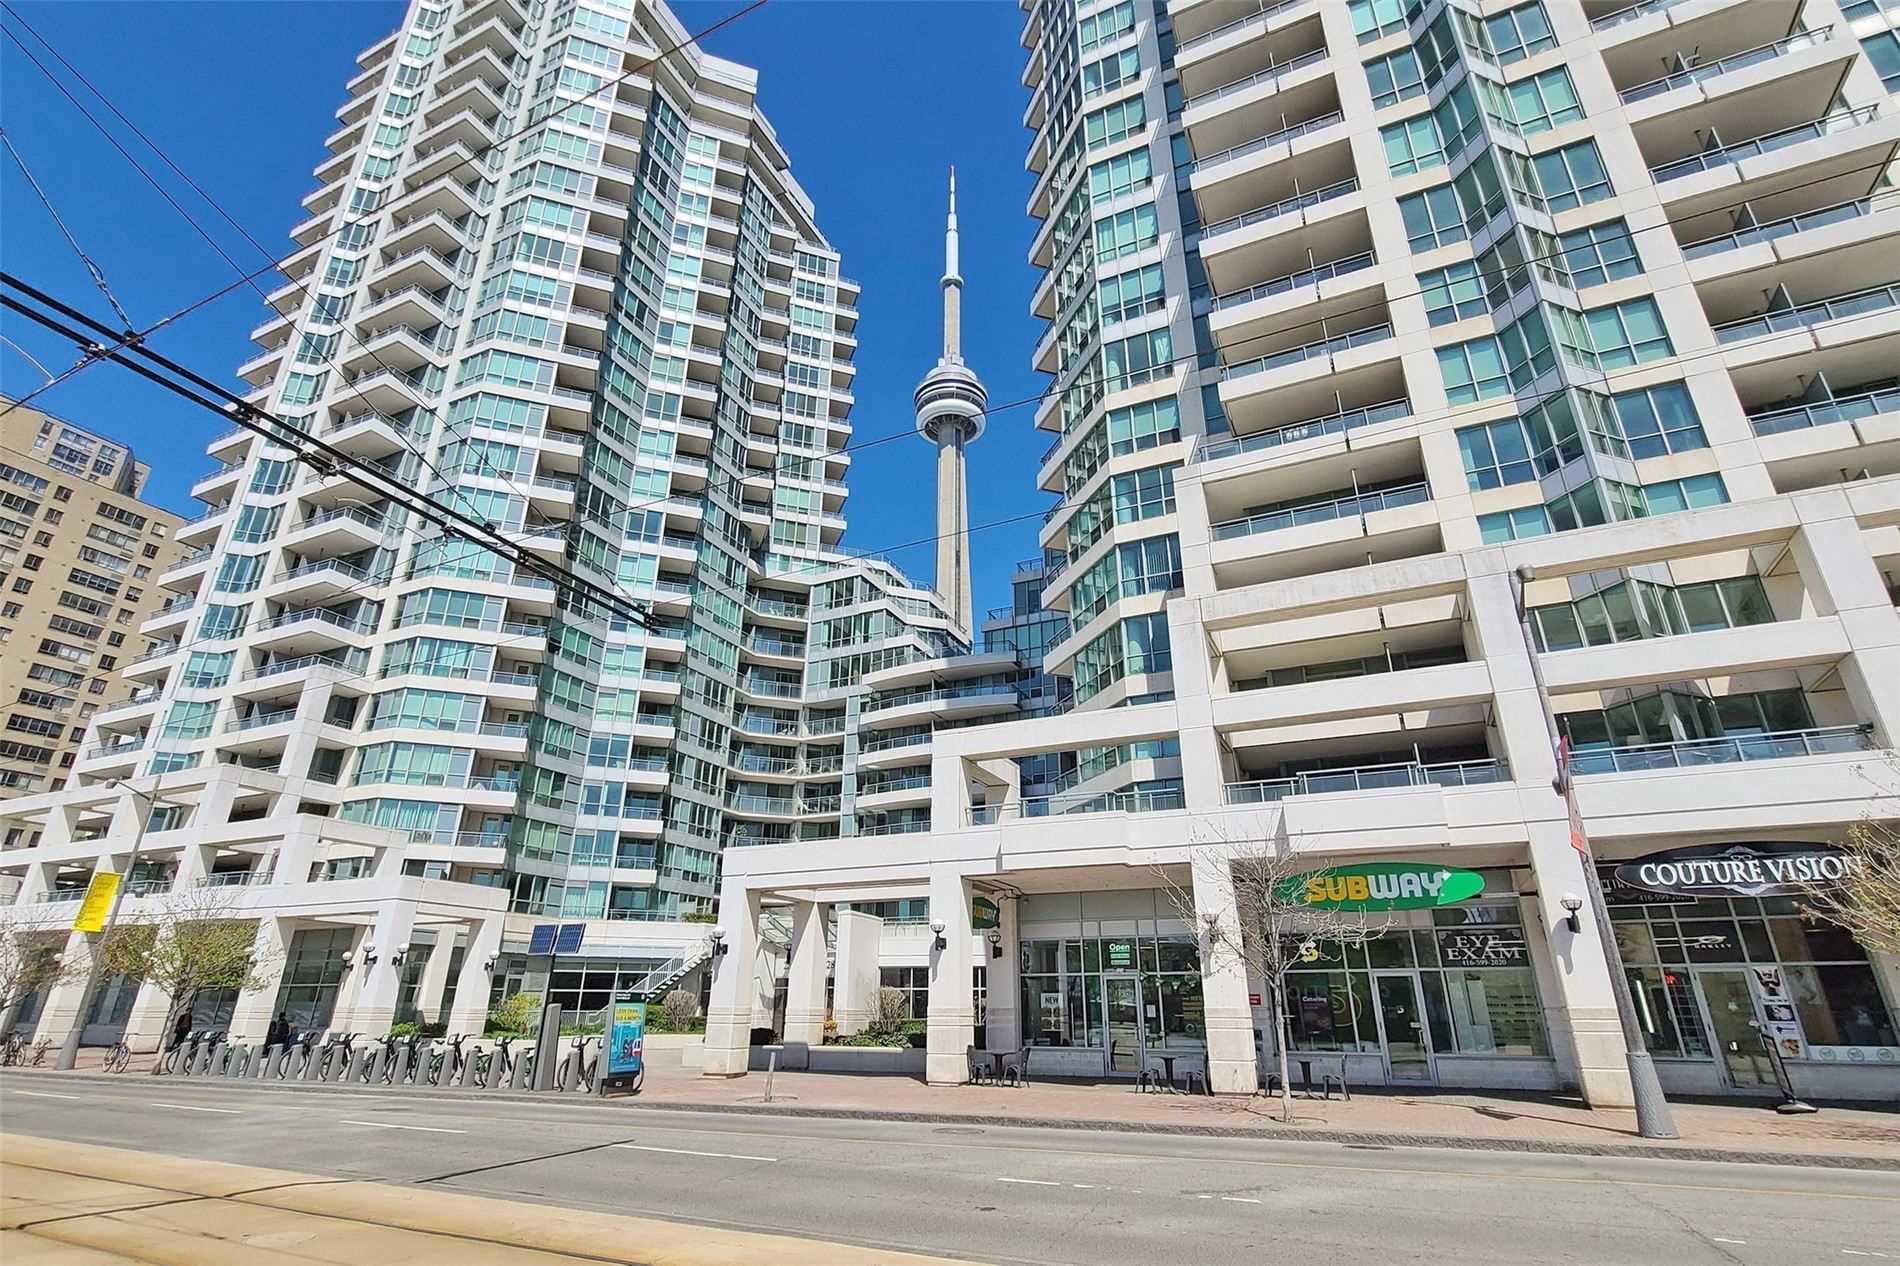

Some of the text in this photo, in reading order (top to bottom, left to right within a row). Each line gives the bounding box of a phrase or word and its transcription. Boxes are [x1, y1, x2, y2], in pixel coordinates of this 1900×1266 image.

[1640, 854, 1865, 886] COUTURE VISION
[1304, 869, 1452, 903] SUBWAY
[1109, 943, 1131, 953] Open
[1454, 934, 1503, 948] EYE
[1446, 946, 1522, 961] EXAM
